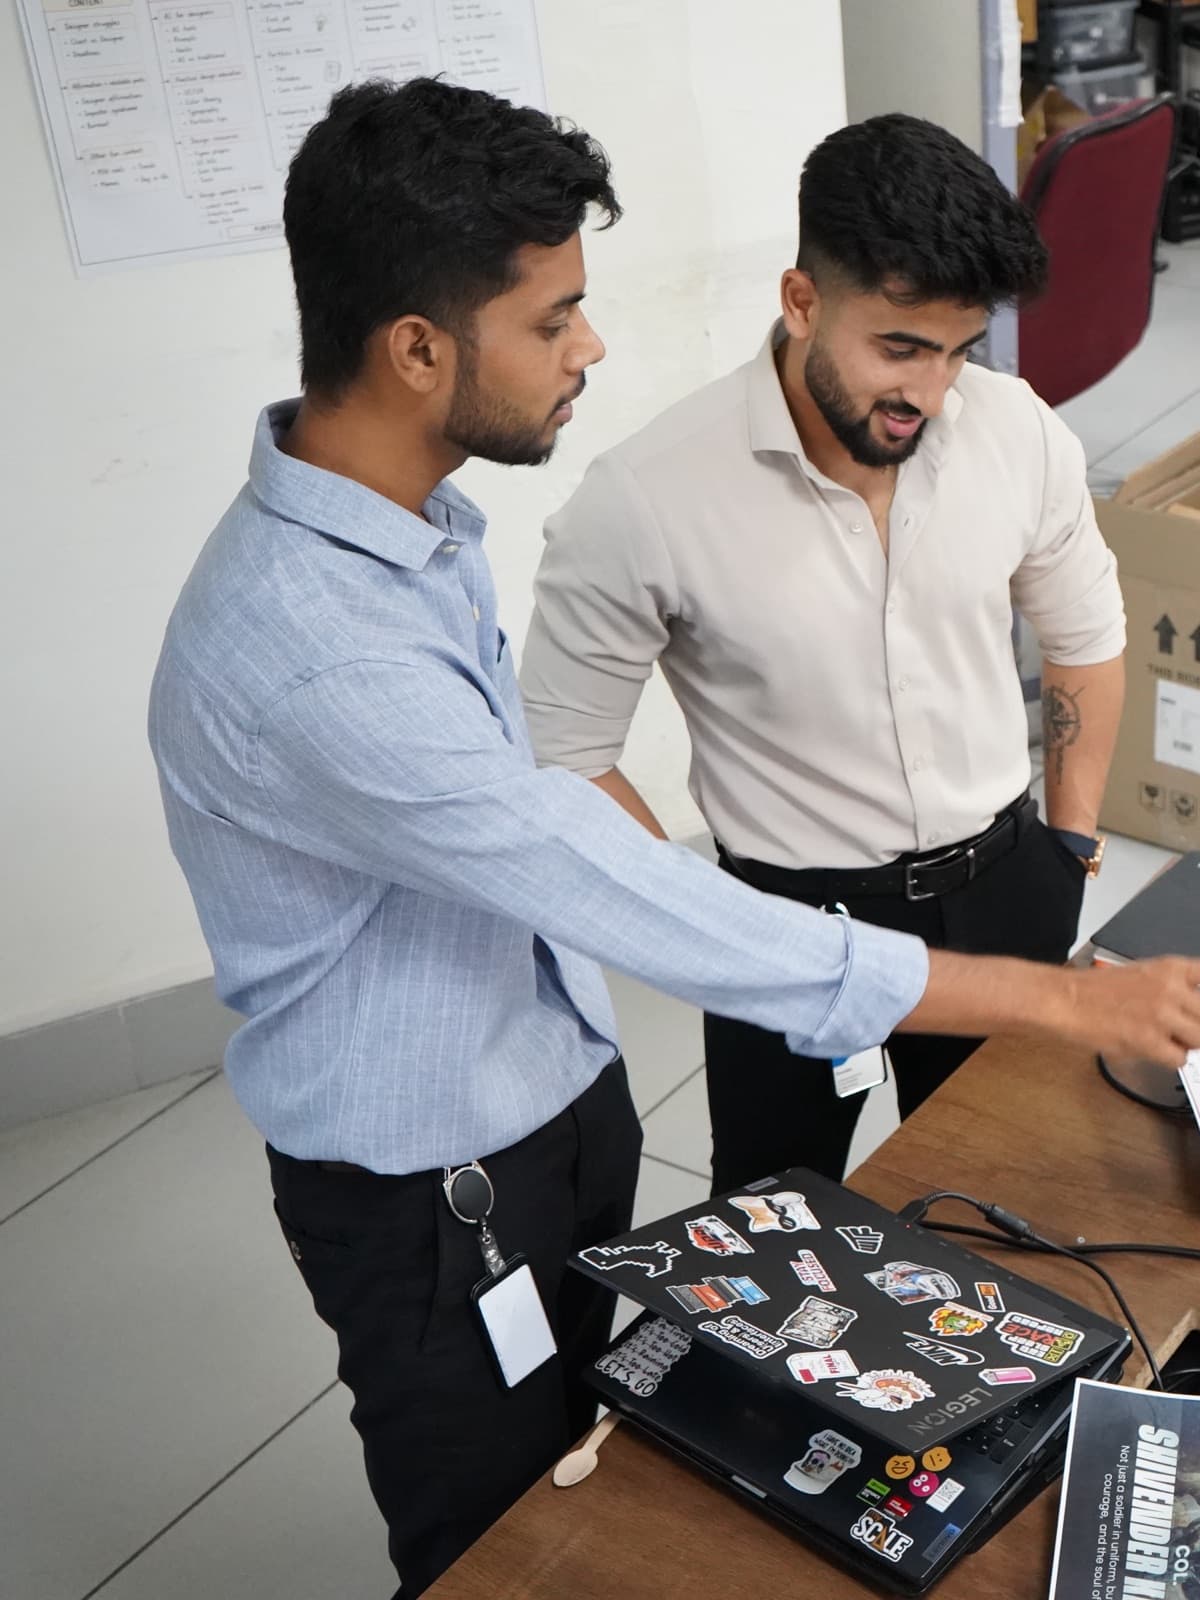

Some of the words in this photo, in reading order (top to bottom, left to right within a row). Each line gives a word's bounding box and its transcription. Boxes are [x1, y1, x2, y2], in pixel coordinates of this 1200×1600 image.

[719, 1327, 768, 1357] Dreaming
[1001, 1322, 1057, 1346] RACE
[596, 1355, 636, 1383] LET'S
[634, 1377, 657, 1395] GO
[907, 1387, 993, 1437] LEGION
[1119, 1445, 1130, 1464] Not
[1116, 1464, 1129, 1481] just
[1098, 1473, 1113, 1519] courage,
[1116, 1485, 1125, 1493] a
[1125, 1424, 1180, 1576] SHIVENDER
[1113, 1495, 1124, 1528] soldier
[853, 1516, 911, 1560] SCALE
[1099, 1524, 1108, 1544] and
[1113, 1530, 1121, 1540] in
[1096, 1547, 1107, 1565] the
[1106, 1542, 1120, 1584] uniform,
[1173, 1545, 1190, 1586] COL.
[1092, 1566, 1104, 1588] soul
